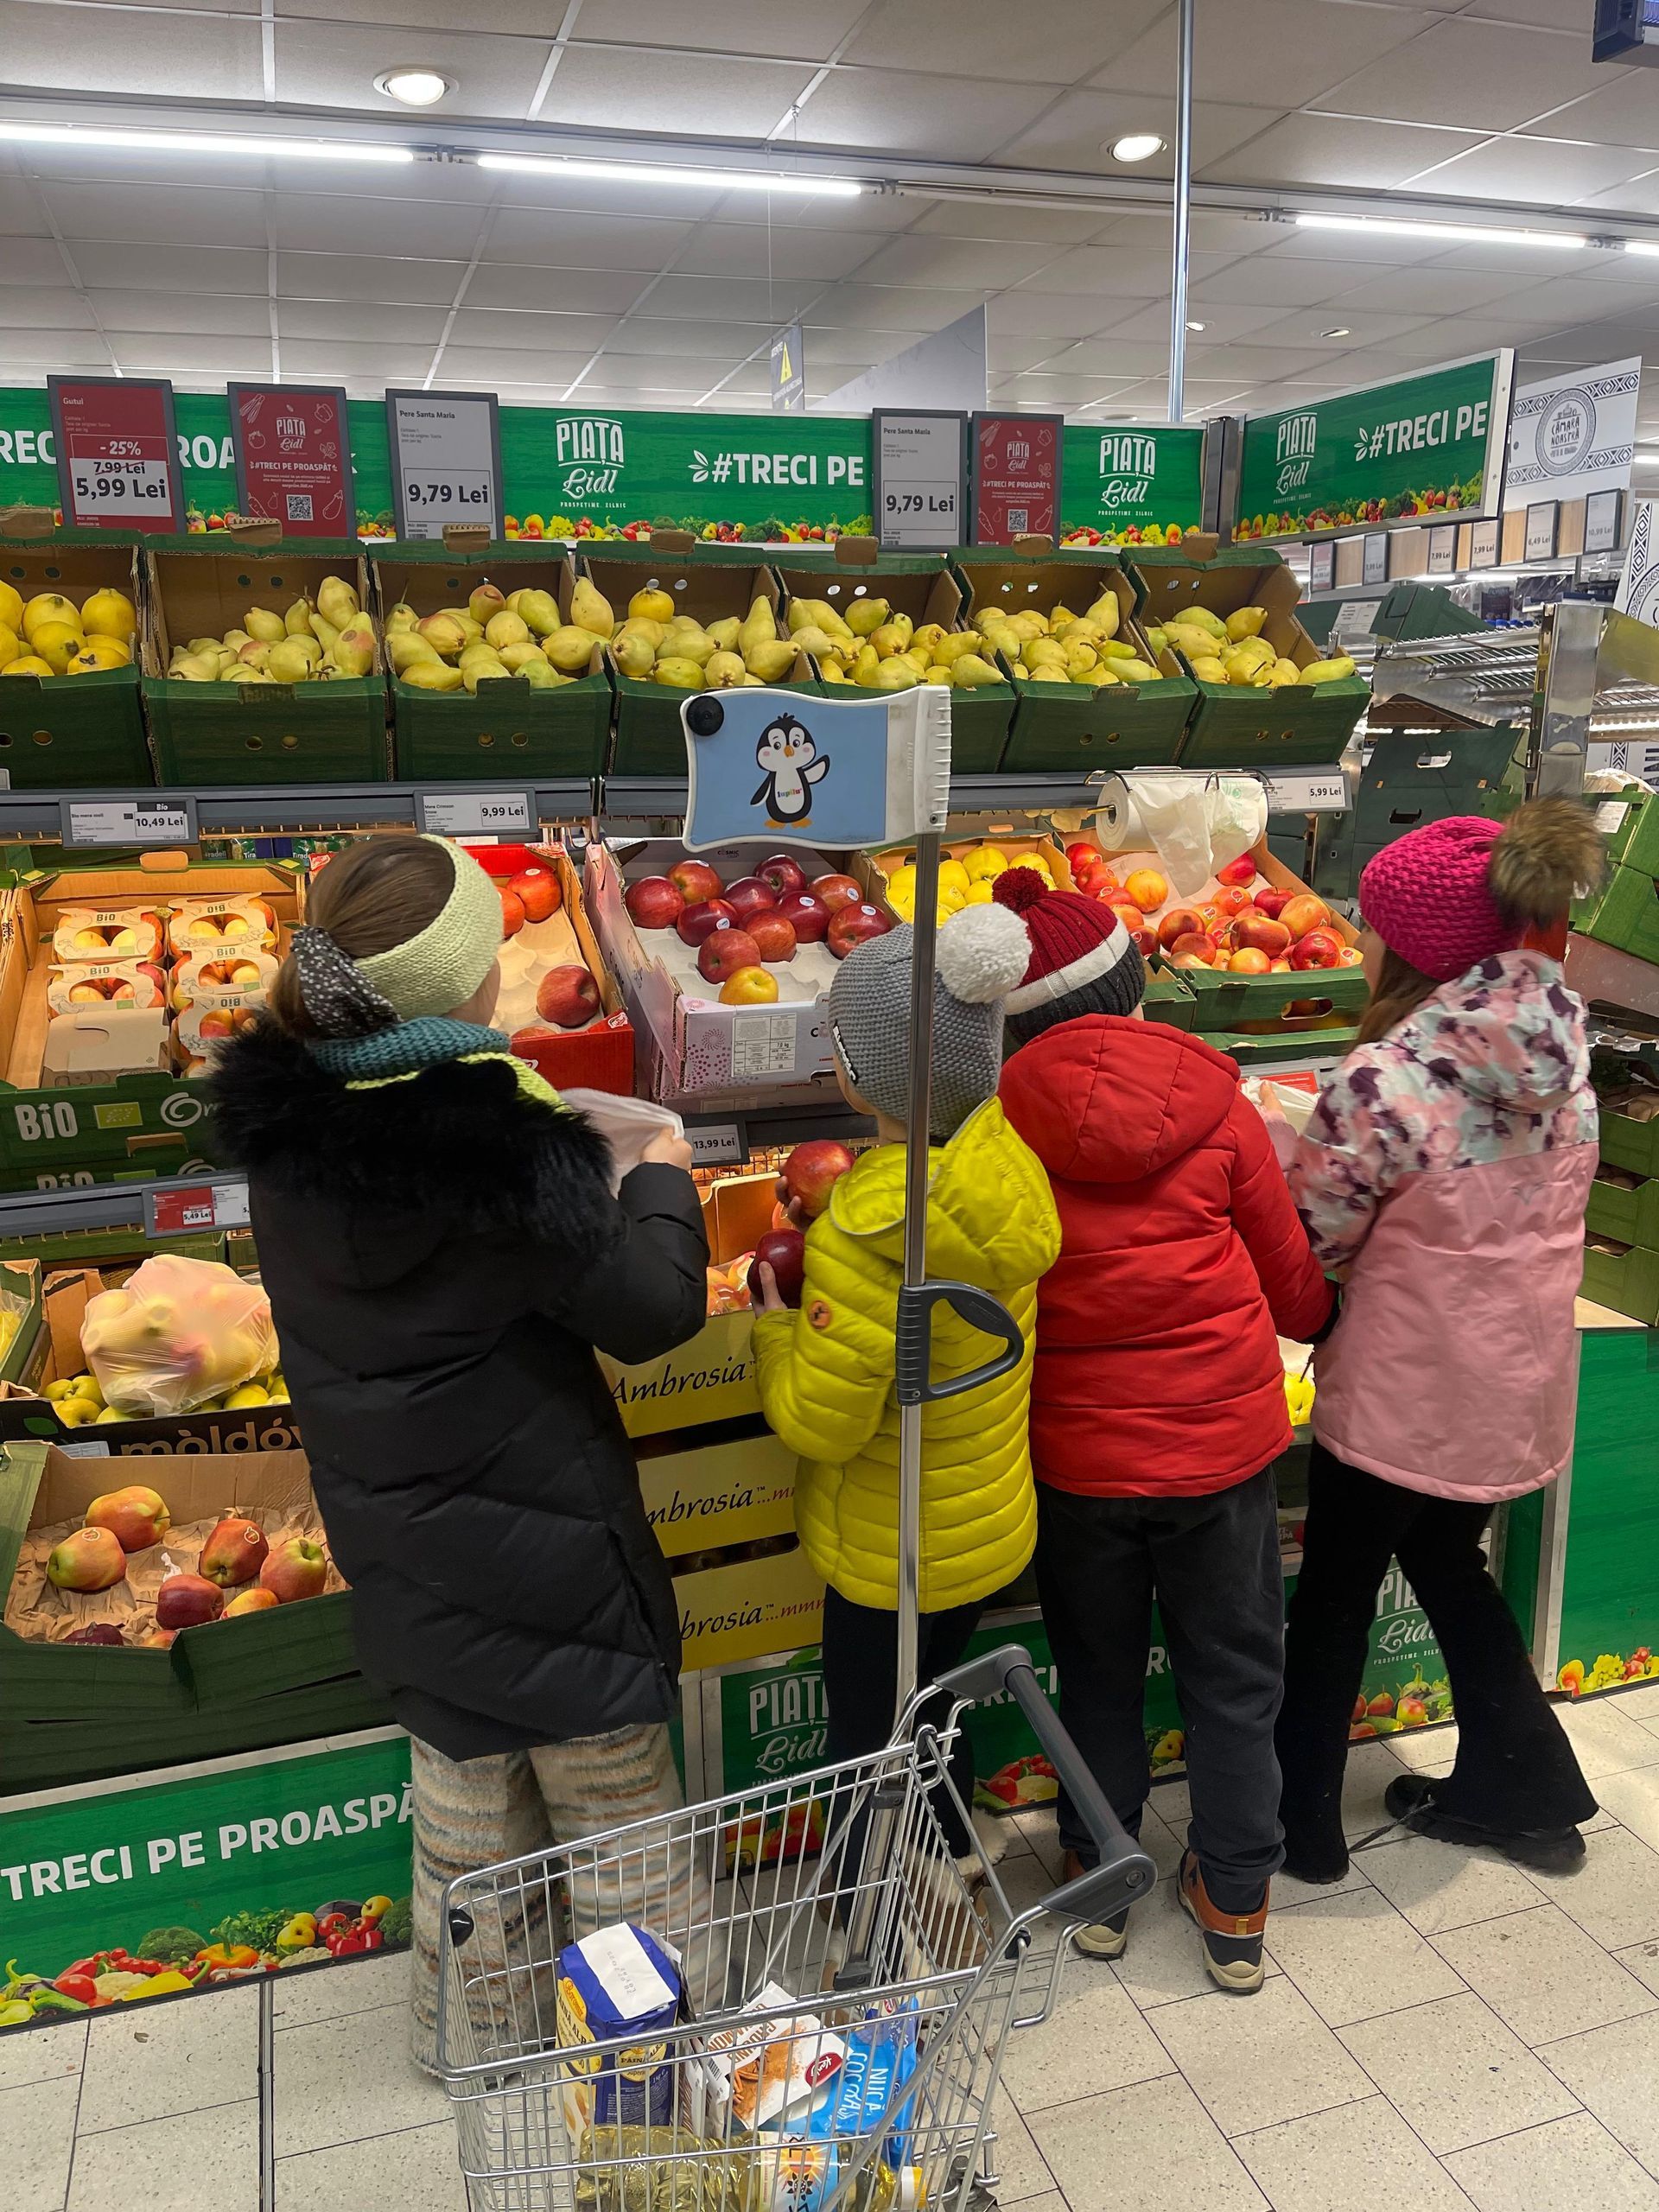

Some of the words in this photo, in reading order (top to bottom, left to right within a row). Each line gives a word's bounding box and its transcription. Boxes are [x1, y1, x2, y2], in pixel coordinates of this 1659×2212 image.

[399, 410, 415, 418] Pere
[1369, 409, 1449, 459] #TRECI
[1454, 400, 1488, 441] PE
[109, 441, 141, 455] 25%
[280, 438, 304, 451] Lidl
[125, 461, 145, 474] Lei
[283, 462, 293, 471] PE
[713, 451, 818, 486] #TRECI
[821, 454, 864, 487] PE
[1008, 460, 1027, 471] Lidl
[563, 468, 619, 499] Lidl
[1275, 461, 1310, 495] Lidl
[76, 478, 125, 499] 5,99
[133, 479, 166, 499] Lei
[408, 484, 452, 505] 9,79
[459, 485, 488, 504] Lei
[1101, 480, 1149, 509] Lidl
[886, 494, 923, 515] 9,79
[929, 494, 954, 512] Lei
[1485, 544, 1495, 553] Lei
[1310, 788, 1327, 798] 5,99
[1329, 787, 1342, 796] Lei
[481, 807, 505, 818] 9,99
[508, 806, 524, 816] Lei
[136, 817, 165, 828] 10,49
[168, 817, 184, 826] Lei
[694, 1139, 719, 1150] 13,99
[721, 1137, 735, 1147] Lei
[755, 1728, 829, 1774] Lidl
[1, 1846, 133, 1901] TRECI
[147, 1831, 206, 1874] PE
